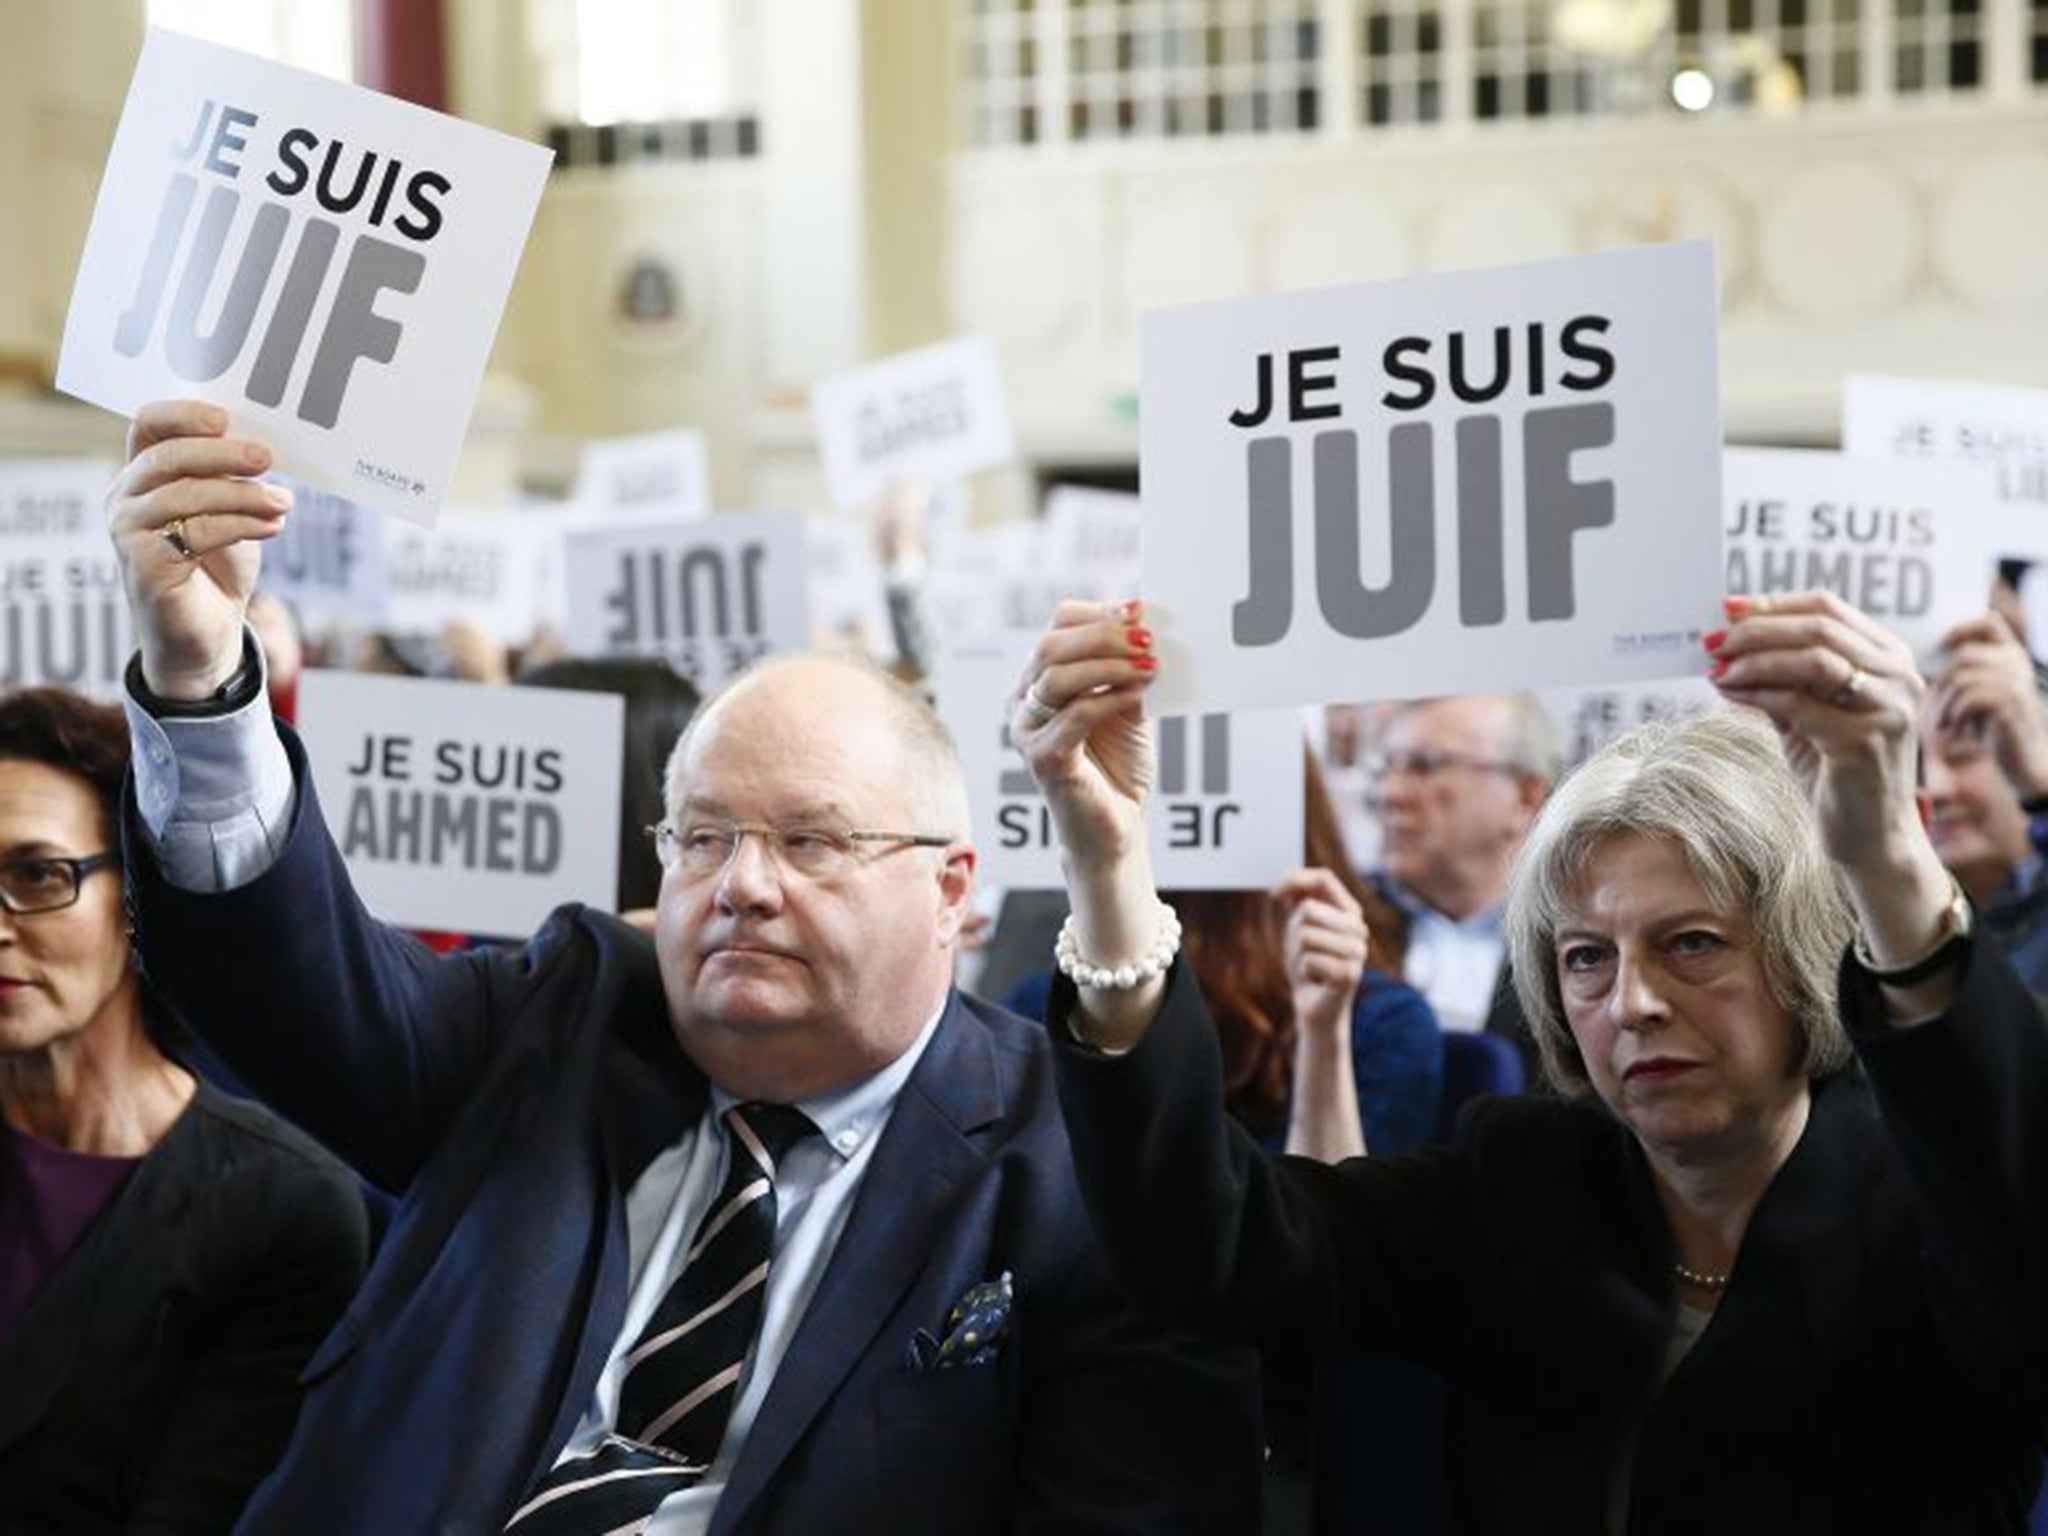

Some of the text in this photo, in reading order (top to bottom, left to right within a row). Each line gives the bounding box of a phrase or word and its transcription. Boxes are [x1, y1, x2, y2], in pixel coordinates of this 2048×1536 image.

[170, 100, 452, 241] JE SUIS
[112, 171, 427, 430] JUIF
[1228, 315, 1616, 428] JE SUIS
[1231, 401, 1616, 648] JUIF
[1726, 501, 1935, 546] JE SUIS
[2, 561, 46, 598] JE
[606, 543, 765, 643] JUIF
[1726, 547, 1933, 617] AHMED
[0, 600, 118, 684] JUI
[348, 735, 564, 795] JE SUIS
[344, 785, 564, 877] AHMED
[1168, 803, 1241, 849] JE
